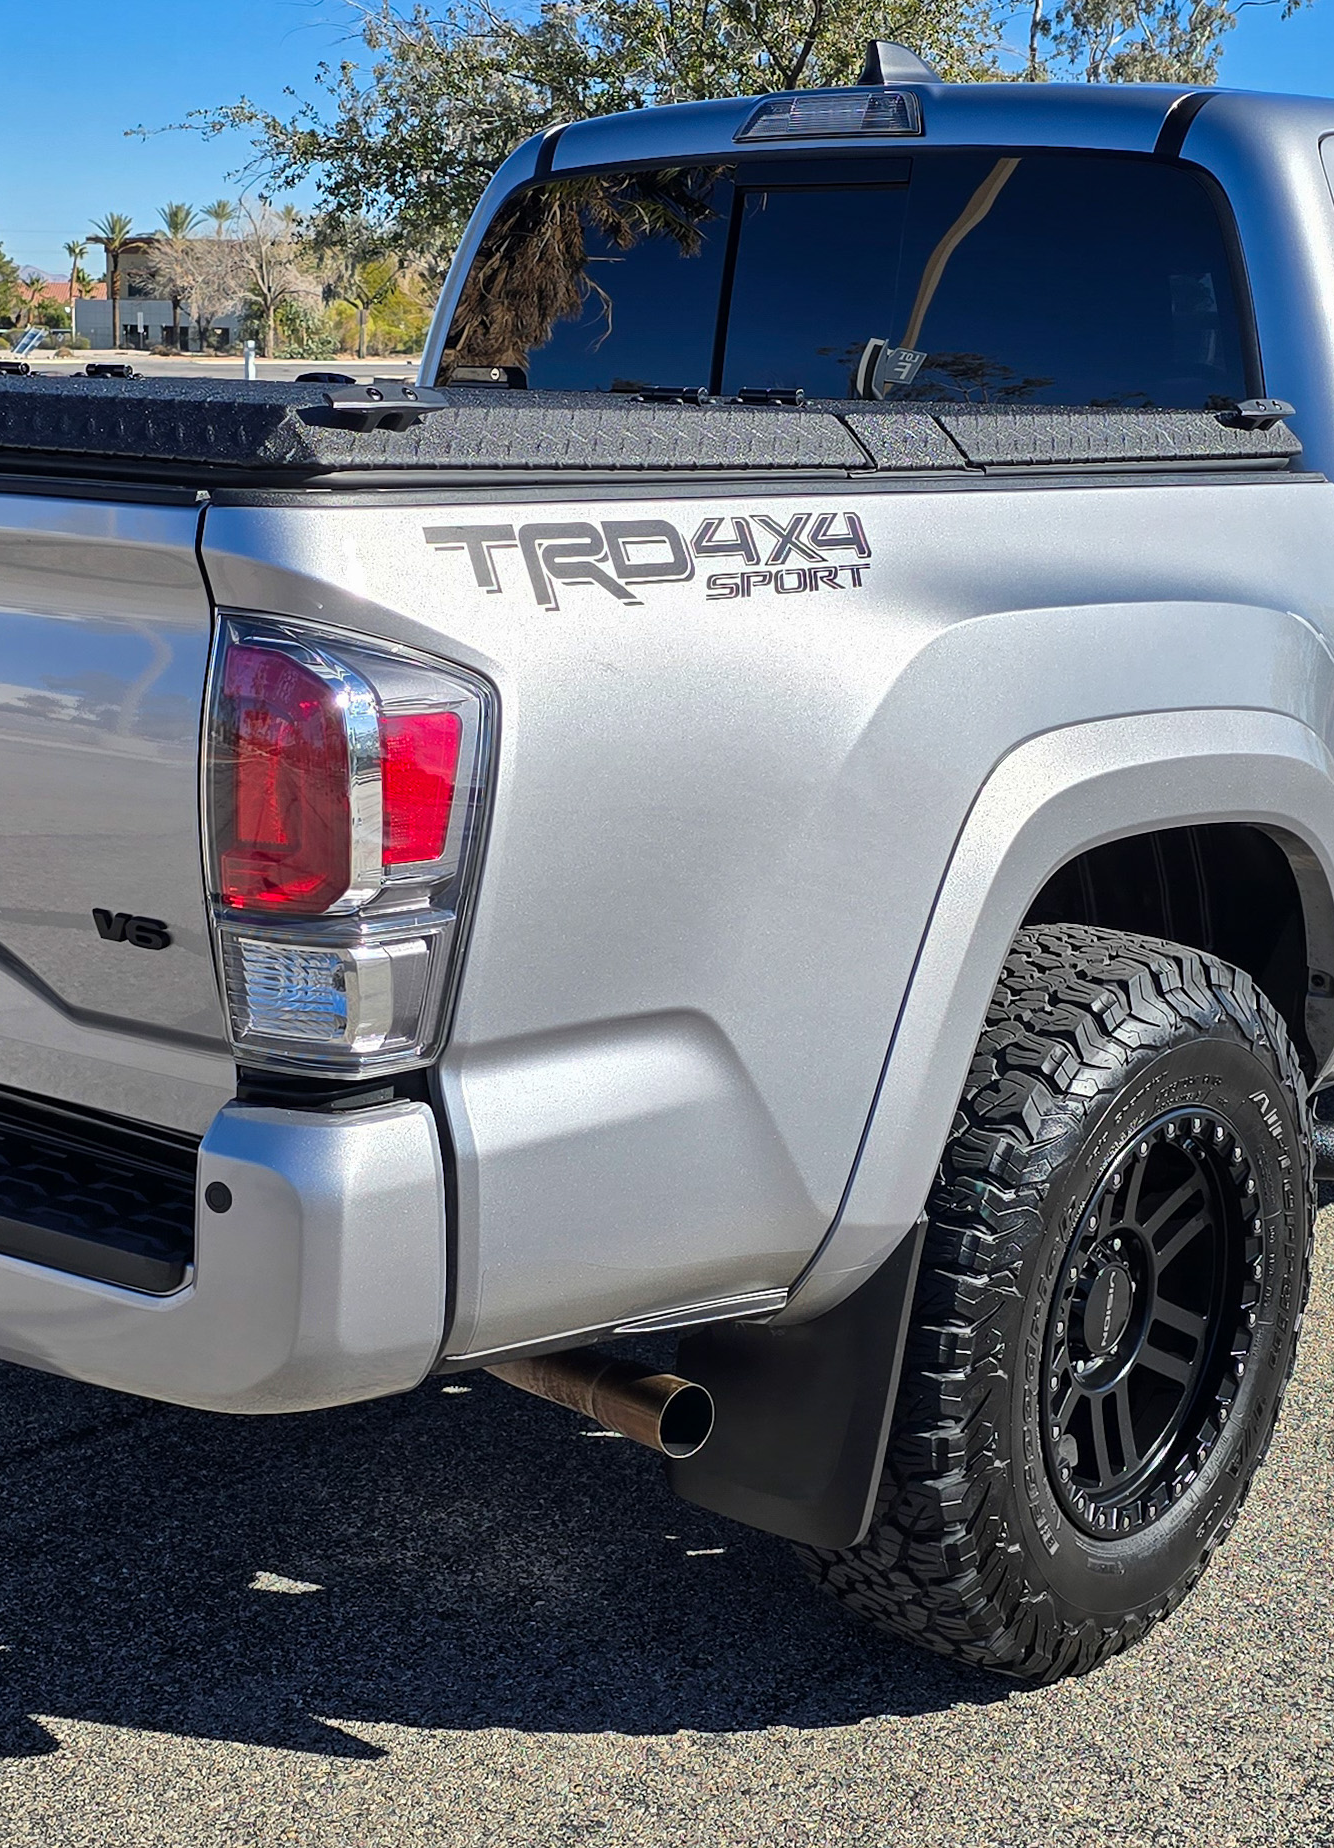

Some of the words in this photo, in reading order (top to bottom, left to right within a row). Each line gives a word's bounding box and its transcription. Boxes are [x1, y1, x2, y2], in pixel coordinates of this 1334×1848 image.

[421, 519, 695, 612] TRD
[705, 563, 872, 602] SPORT
[91, 906, 172, 951] V6
[1100, 1270, 1118, 1347] VISION
